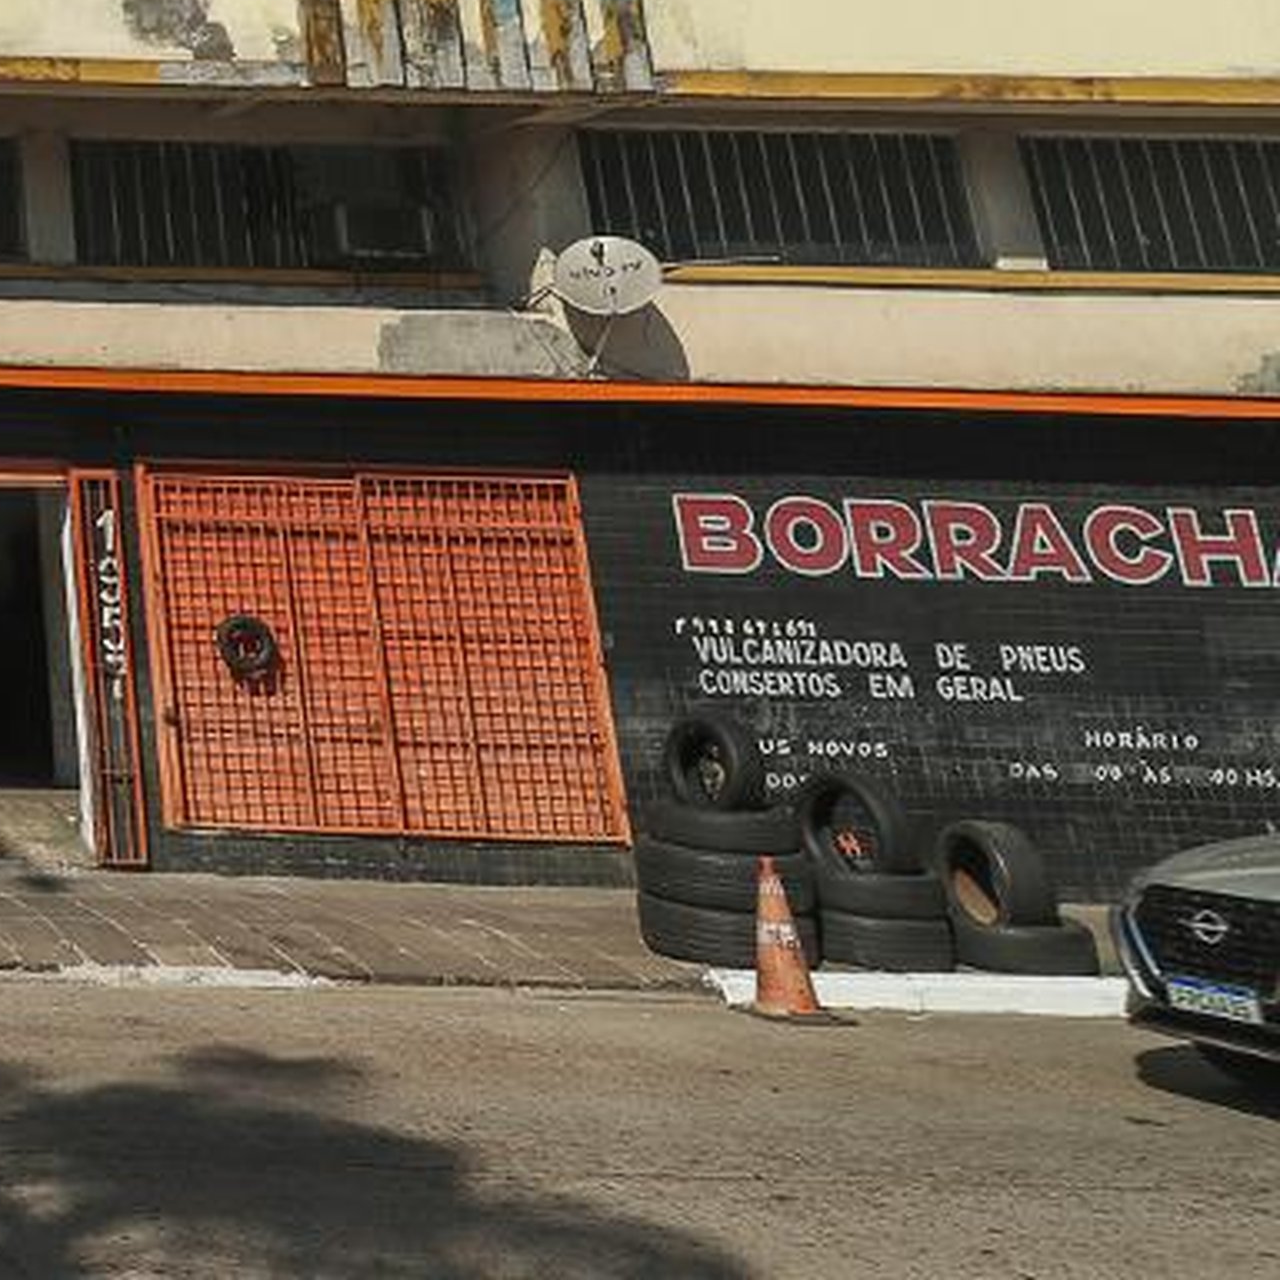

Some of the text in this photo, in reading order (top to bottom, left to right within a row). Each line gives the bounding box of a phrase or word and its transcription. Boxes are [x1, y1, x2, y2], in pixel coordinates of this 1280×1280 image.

[673, 493, 1280, 587] BORRACH
[692, 636, 1086, 673] VULCANIZADORA DE PNEUS
[699, 669, 1025, 702] CONSERTOS EM GERAL
[807, 741, 889, 759] NOVOS
